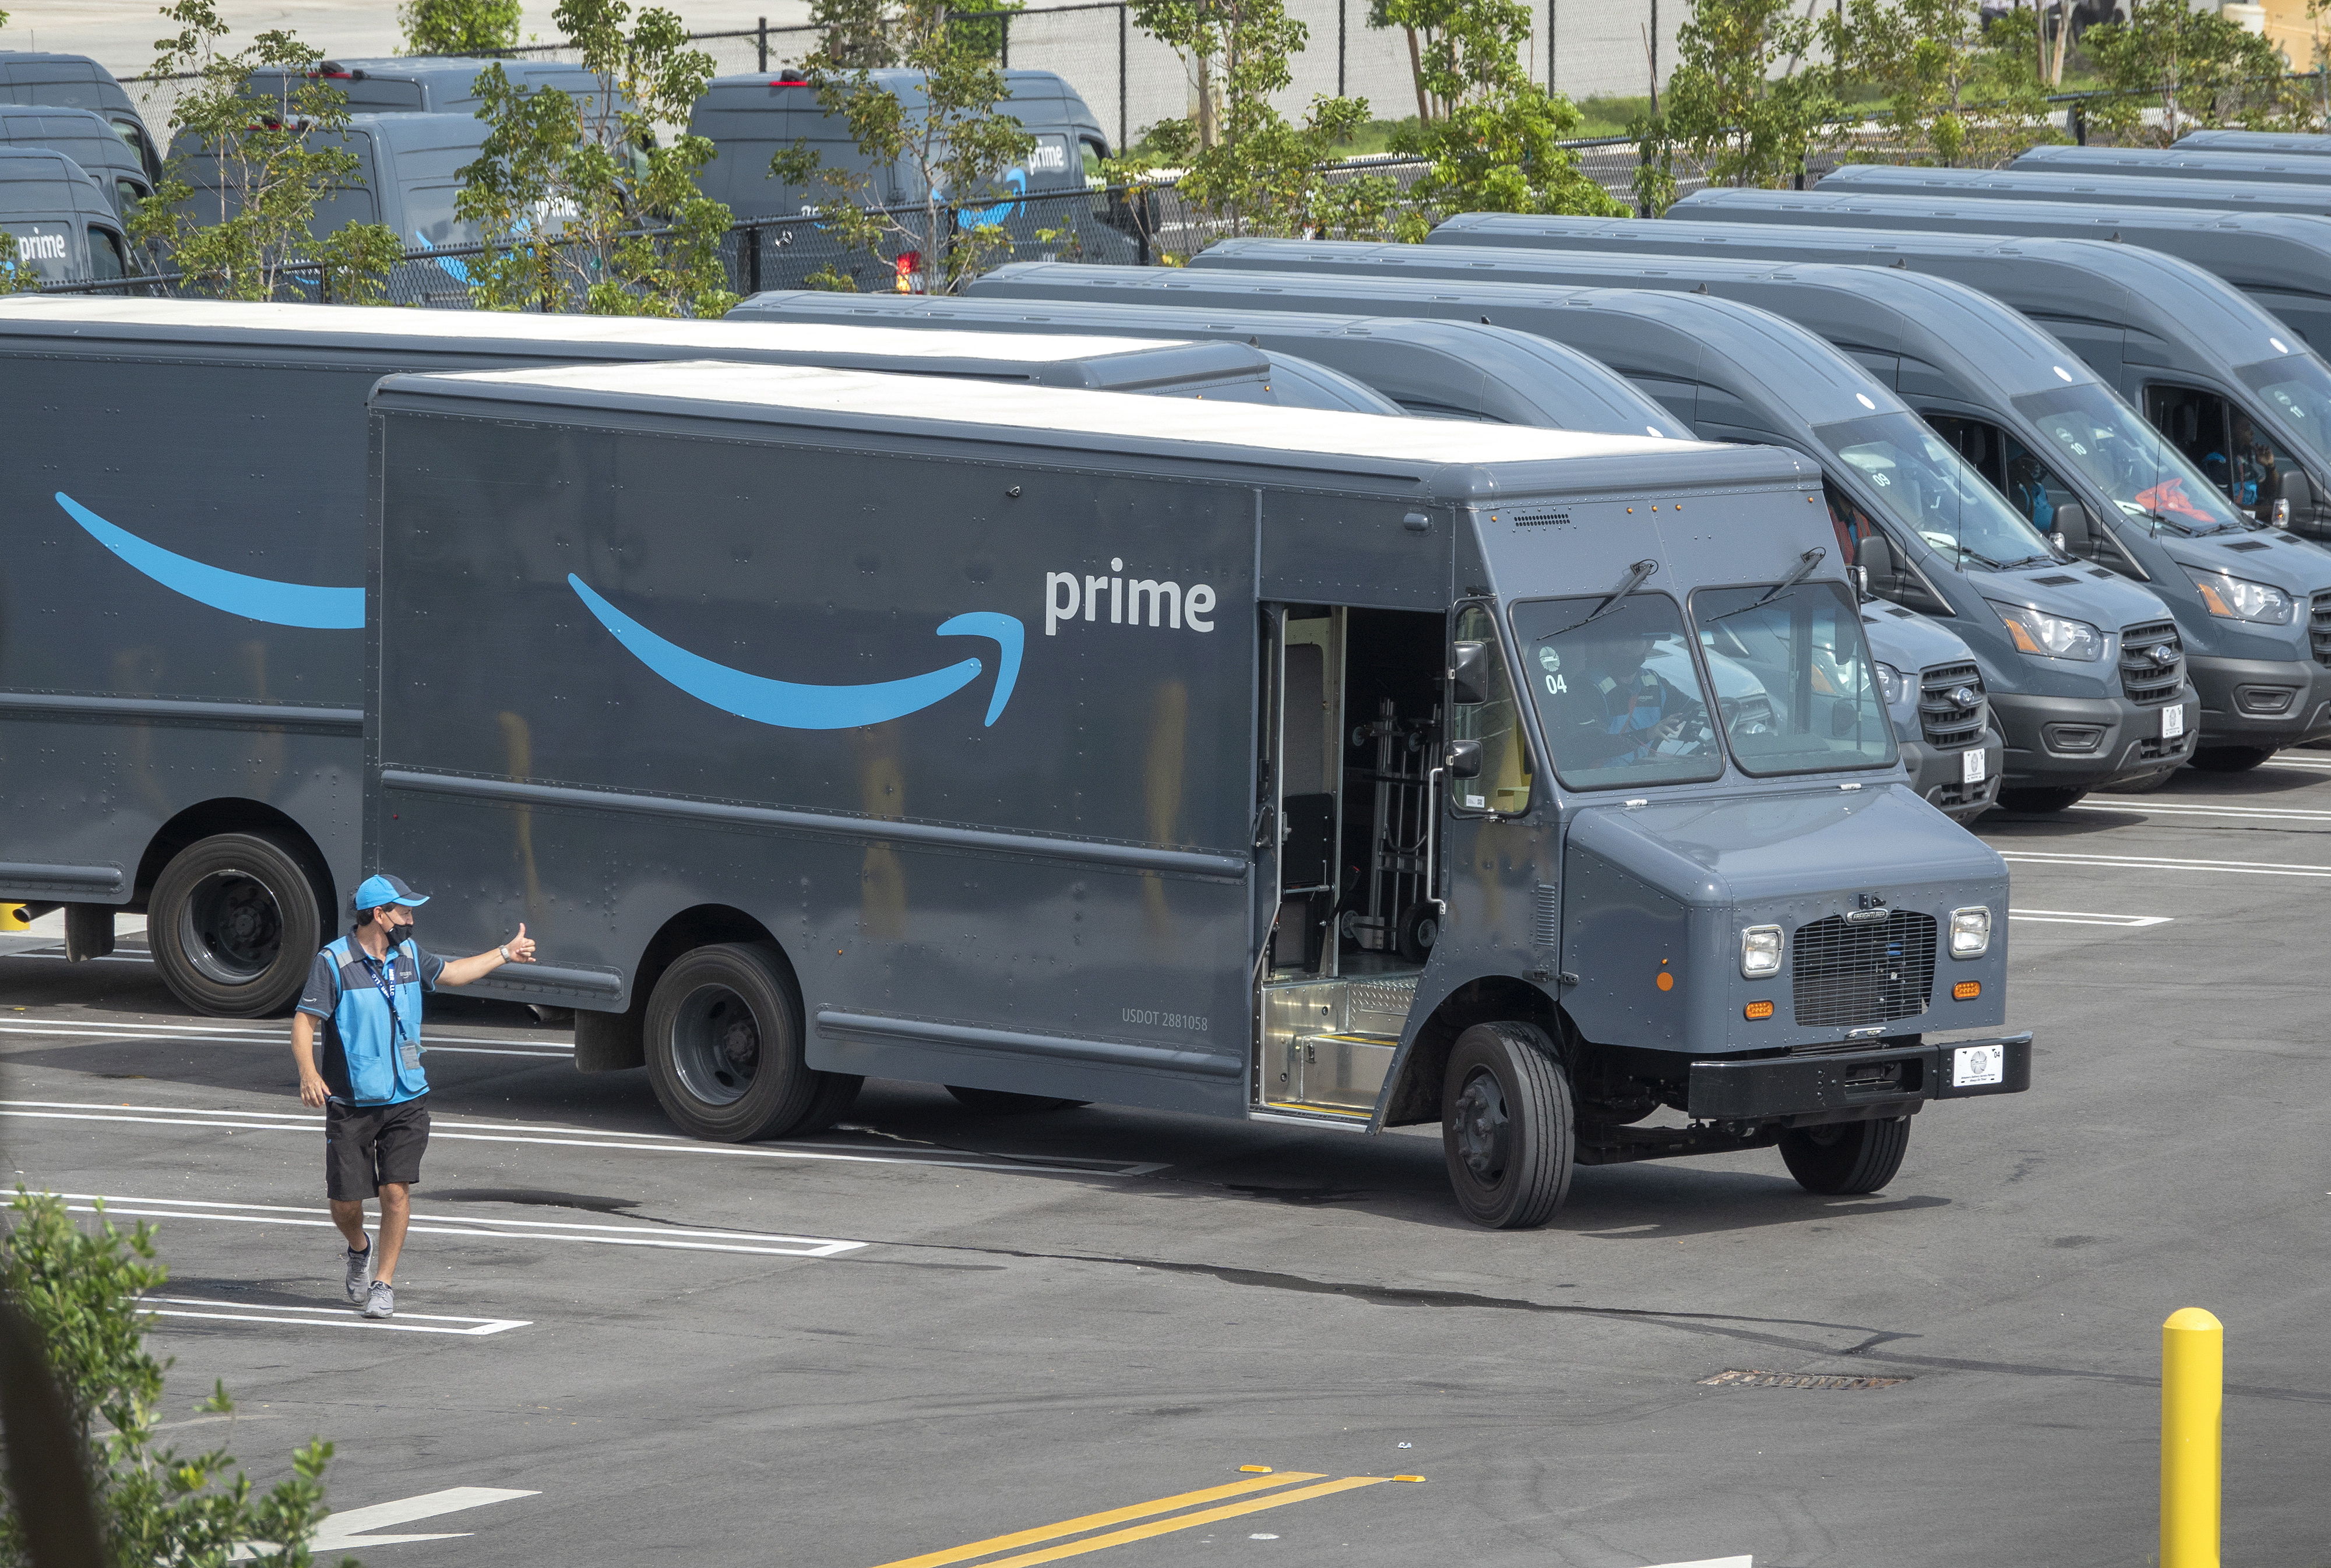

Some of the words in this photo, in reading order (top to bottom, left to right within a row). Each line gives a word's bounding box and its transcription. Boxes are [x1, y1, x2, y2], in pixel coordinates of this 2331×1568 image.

[1027, 139, 1064, 176] prime
[18, 226, 66, 262] prime
[2290, 405, 2305, 418] 11
[2071, 442, 2087, 456] 10
[1872, 473, 1891, 487] 09
[1045, 557, 1216, 636] prime
[1545, 674, 1568, 695] 04
[1853, 911, 1886, 920] FREIGHTLINER
[371, 974, 381, 985] LLC
[1122, 1007, 1160, 1026] USDOT
[1162, 1012, 1207, 1031] 2881058
